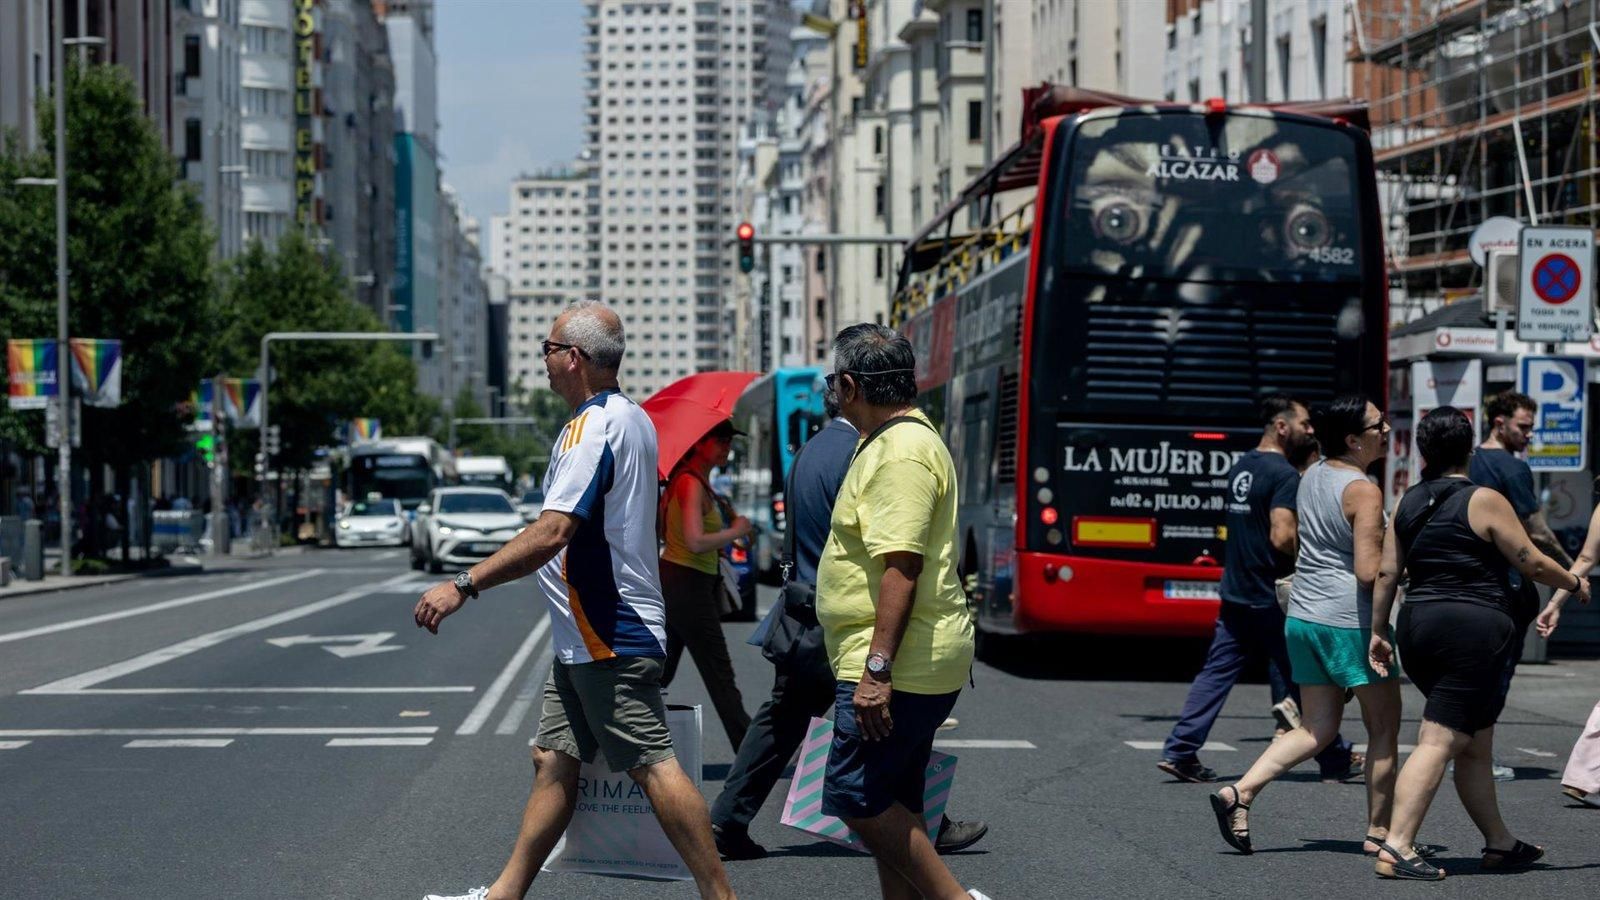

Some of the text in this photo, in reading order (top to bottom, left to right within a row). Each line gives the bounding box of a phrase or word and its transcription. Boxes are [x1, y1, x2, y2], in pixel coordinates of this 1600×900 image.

[295, 0, 314, 115] OTEL
[1145, 160, 1240, 182] ALCÁZAR
[1526, 239, 1588, 249] EN ACERA
[1308, 246, 1354, 265] 4582
[1063, 446, 1103, 473] LA
[1109, 441, 1203, 475] MUJER
[1126, 493, 1141, 508] 02
[1155, 494, 1201, 512] JULIO
[576, 777, 644, 800] RIMA
[602, 804, 620, 813] THE
